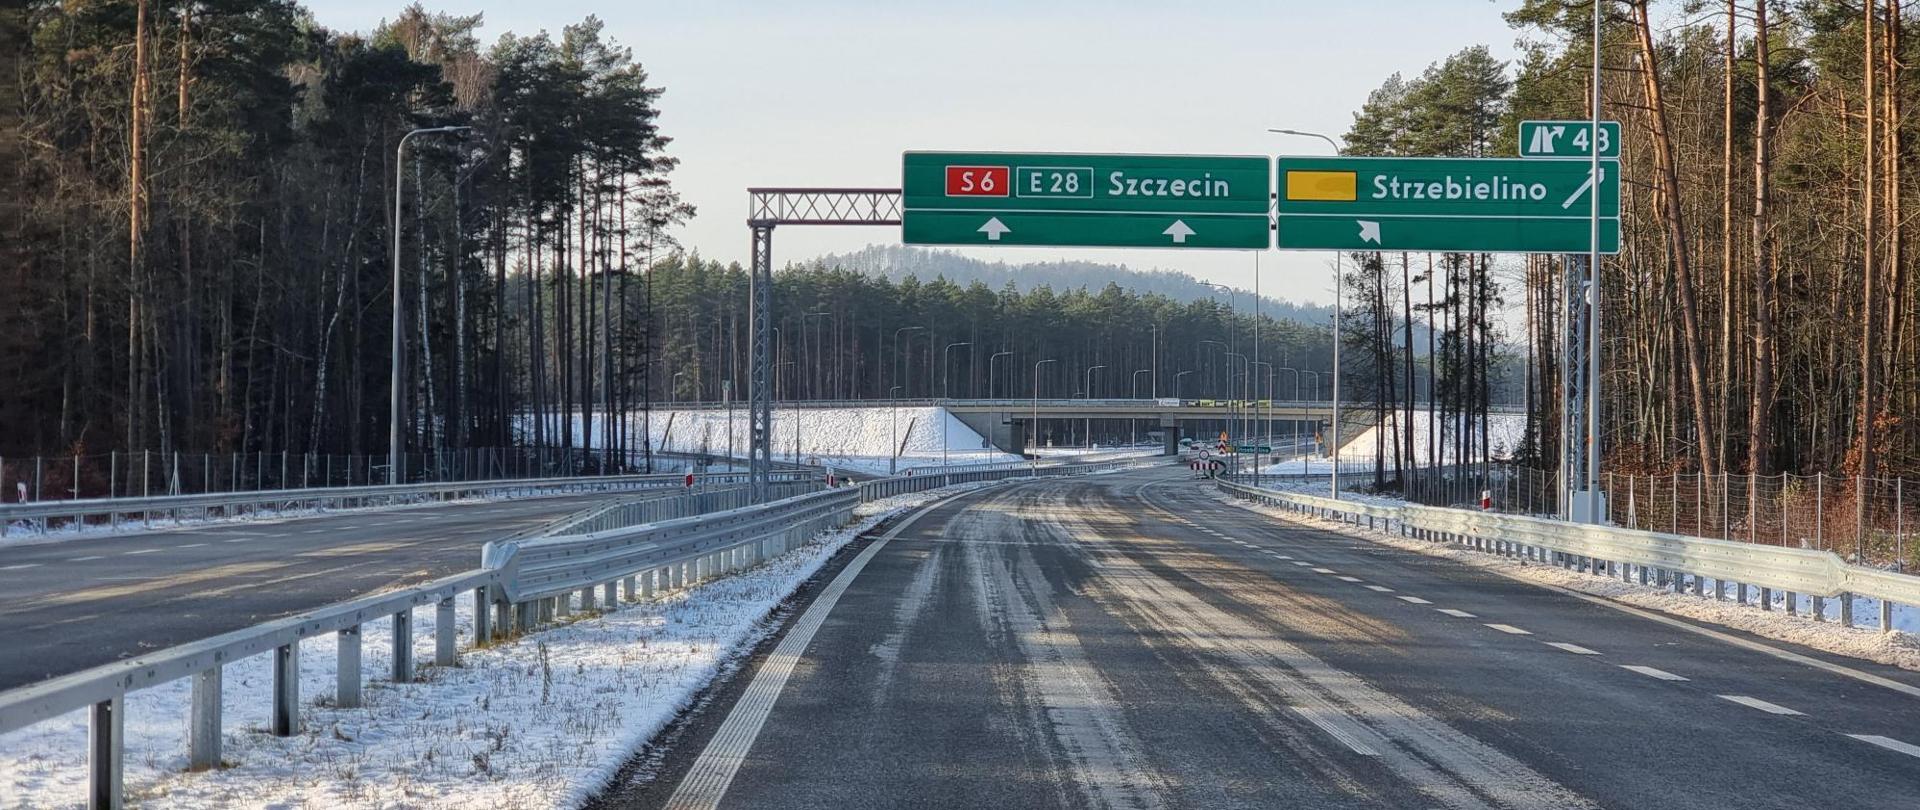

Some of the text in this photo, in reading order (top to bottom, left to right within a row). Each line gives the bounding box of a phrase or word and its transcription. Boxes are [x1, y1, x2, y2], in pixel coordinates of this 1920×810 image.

[961, 171, 1229, 197] S 6 E 28 Szczecin
[1371, 174, 1547, 201] Strzebielino
